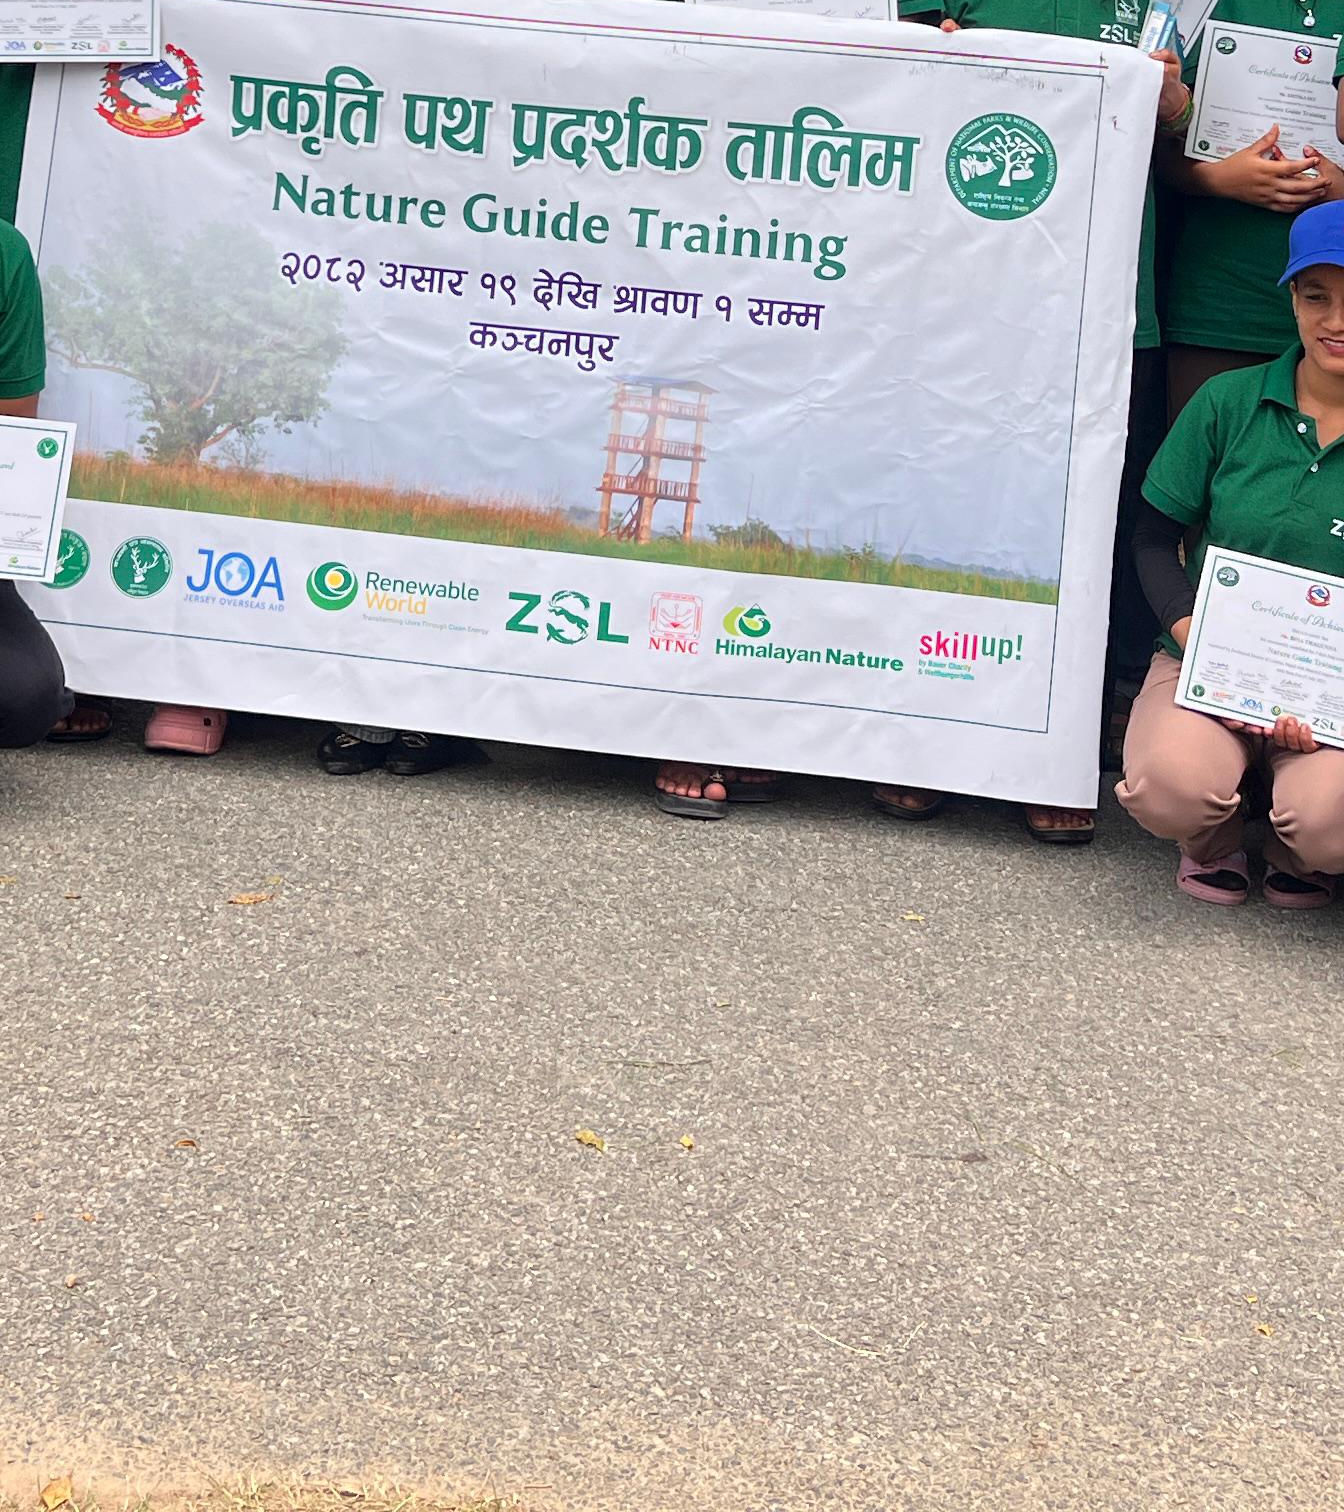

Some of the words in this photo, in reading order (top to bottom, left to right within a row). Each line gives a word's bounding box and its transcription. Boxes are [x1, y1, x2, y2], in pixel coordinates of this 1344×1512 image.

[71, 40, 93, 51] ZSL
[1100, 24, 1133, 44] ZSL
[231, 66, 384, 155] प्रकृति
[402, 93, 493, 154] पथ
[511, 96, 708, 172] प्रदर्शक
[725, 106, 920, 192] तालिम
[273, 172, 446, 228] Nature
[463, 193, 609, 244] Guide
[629, 207, 848, 281] Training
[281, 252, 365, 292] २०८२
[379, 263, 469, 297] असार
[480, 273, 516, 306] १९
[533, 268, 602, 312] देखि
[613, 286, 703, 319] श्रावण
[715, 295, 732, 322] १
[747, 298, 826, 331] सम्म
[469, 322, 620, 373] कञ्चनपुर
[186, 548, 286, 601] JOA
[365, 571, 480, 602] Renewable
[183, 594, 216, 605] JERSEY
[218, 596, 266, 610] OVERSEAS
[268, 602, 285, 612] AID
[365, 590, 427, 615] World
[505, 589, 630, 646] ZSL
[648, 637, 699, 655] NTNC
[715, 637, 822, 666] Himalayan
[825, 647, 905, 673] Nature
[1311, 717, 1337, 732] ZSL
